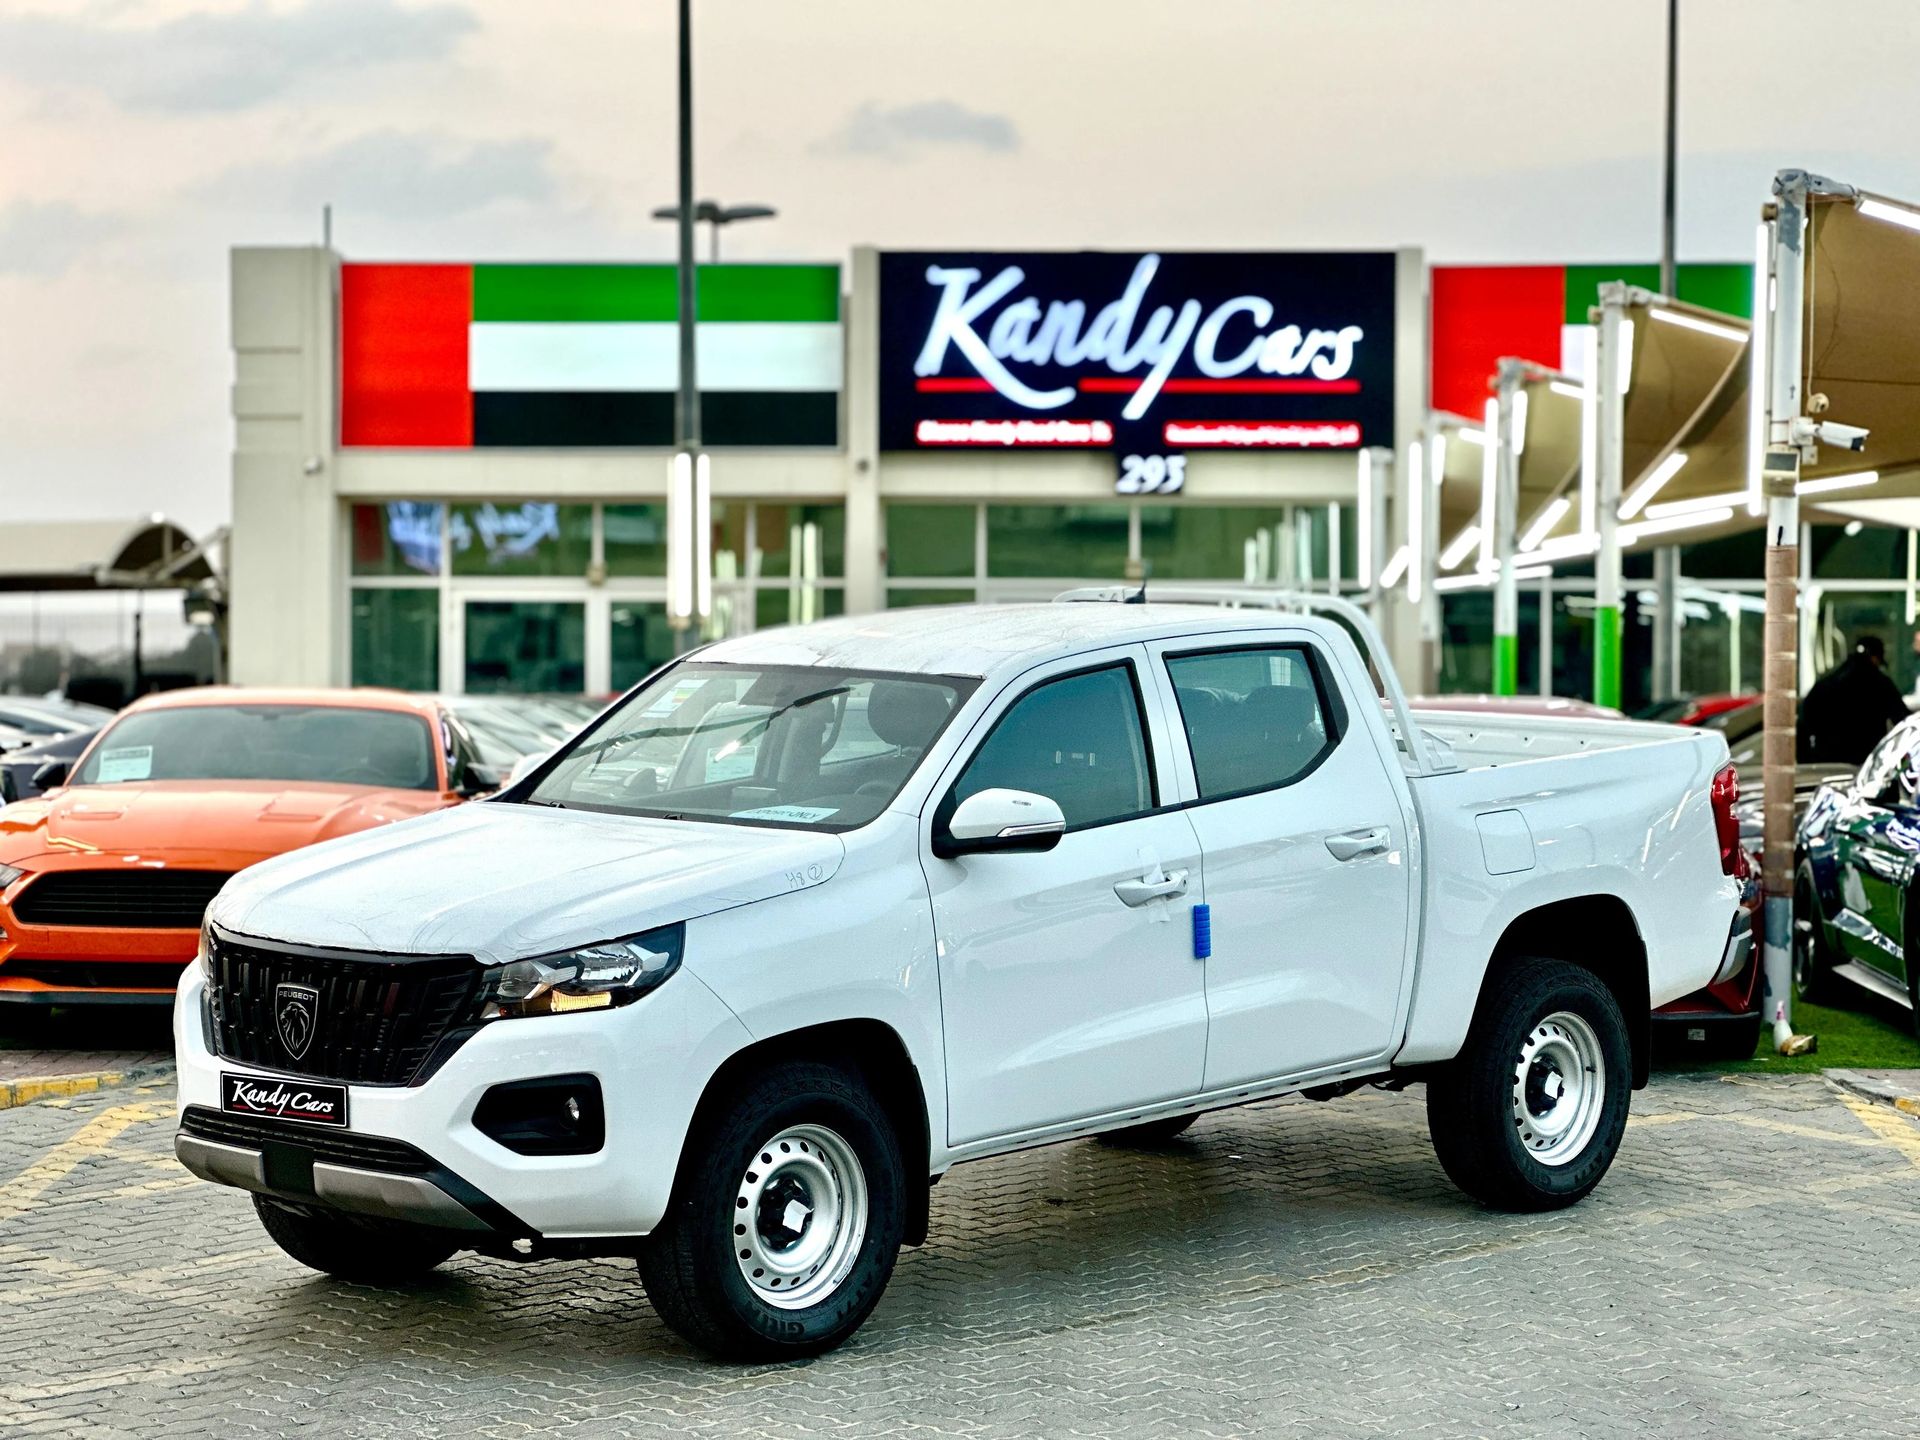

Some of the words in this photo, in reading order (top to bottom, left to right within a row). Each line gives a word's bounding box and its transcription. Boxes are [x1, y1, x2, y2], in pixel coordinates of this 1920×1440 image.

[915, 253, 1202, 421] Kandy
[1194, 296, 1363, 380] Cars
[1115, 454, 1187, 494] 295
[278, 990, 314, 1001] PEUGEOT
[232, 1080, 291, 1116] Kandy
[290, 1092, 334, 1112] Cars
